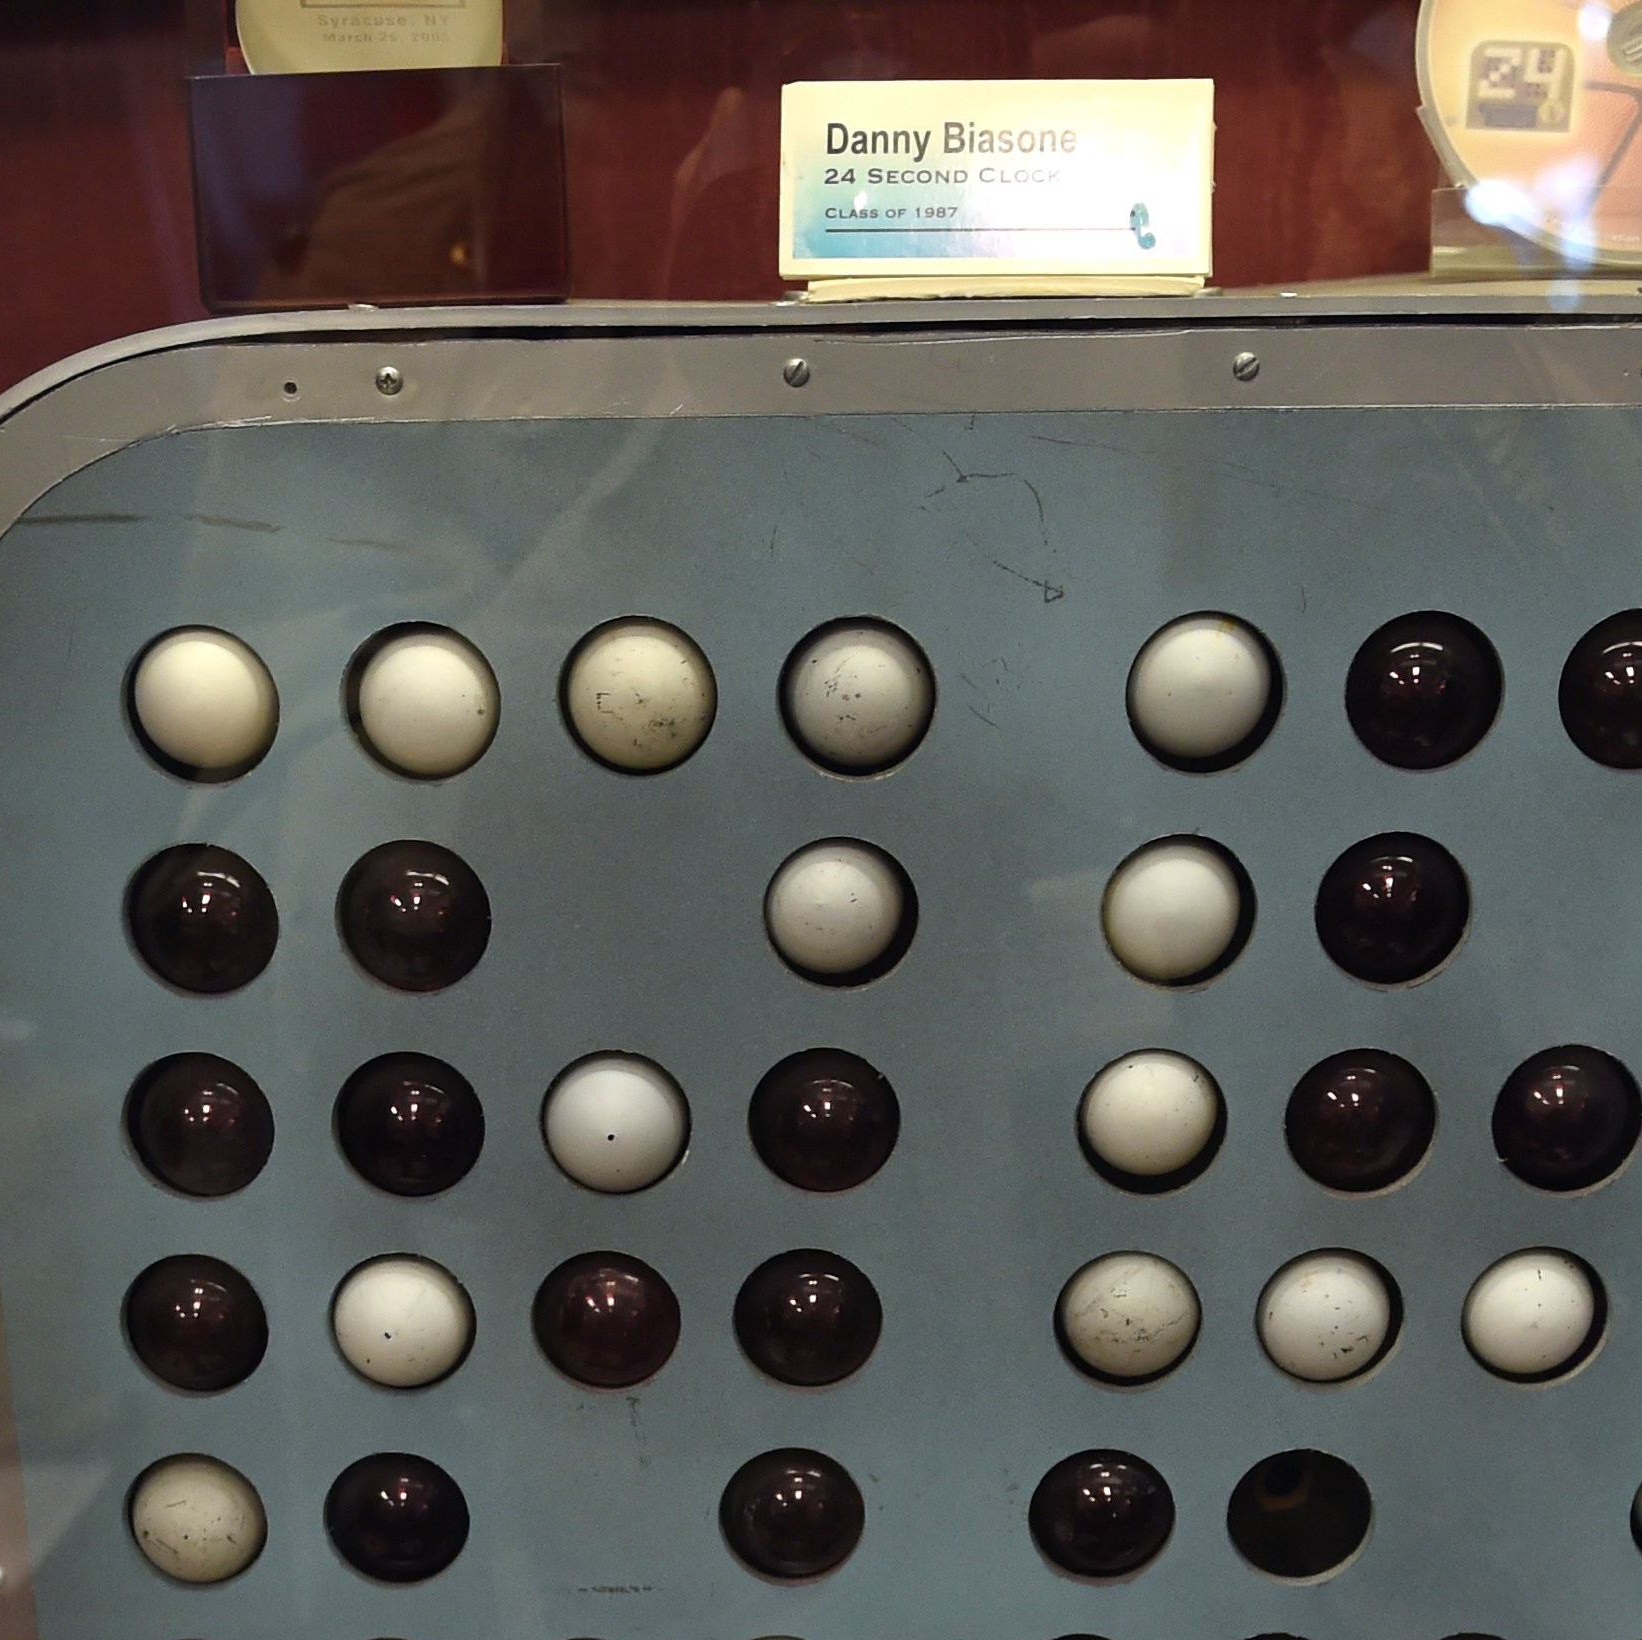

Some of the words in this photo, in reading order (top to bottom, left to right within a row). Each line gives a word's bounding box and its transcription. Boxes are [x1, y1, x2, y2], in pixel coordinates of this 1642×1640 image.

[827, 122, 932, 163] Danny
[943, 121, 1077, 154] Biasone
[824, 168, 857, 185] 24
[868, 167, 969, 185] SECOND
[915, 207, 958, 219] 1987
